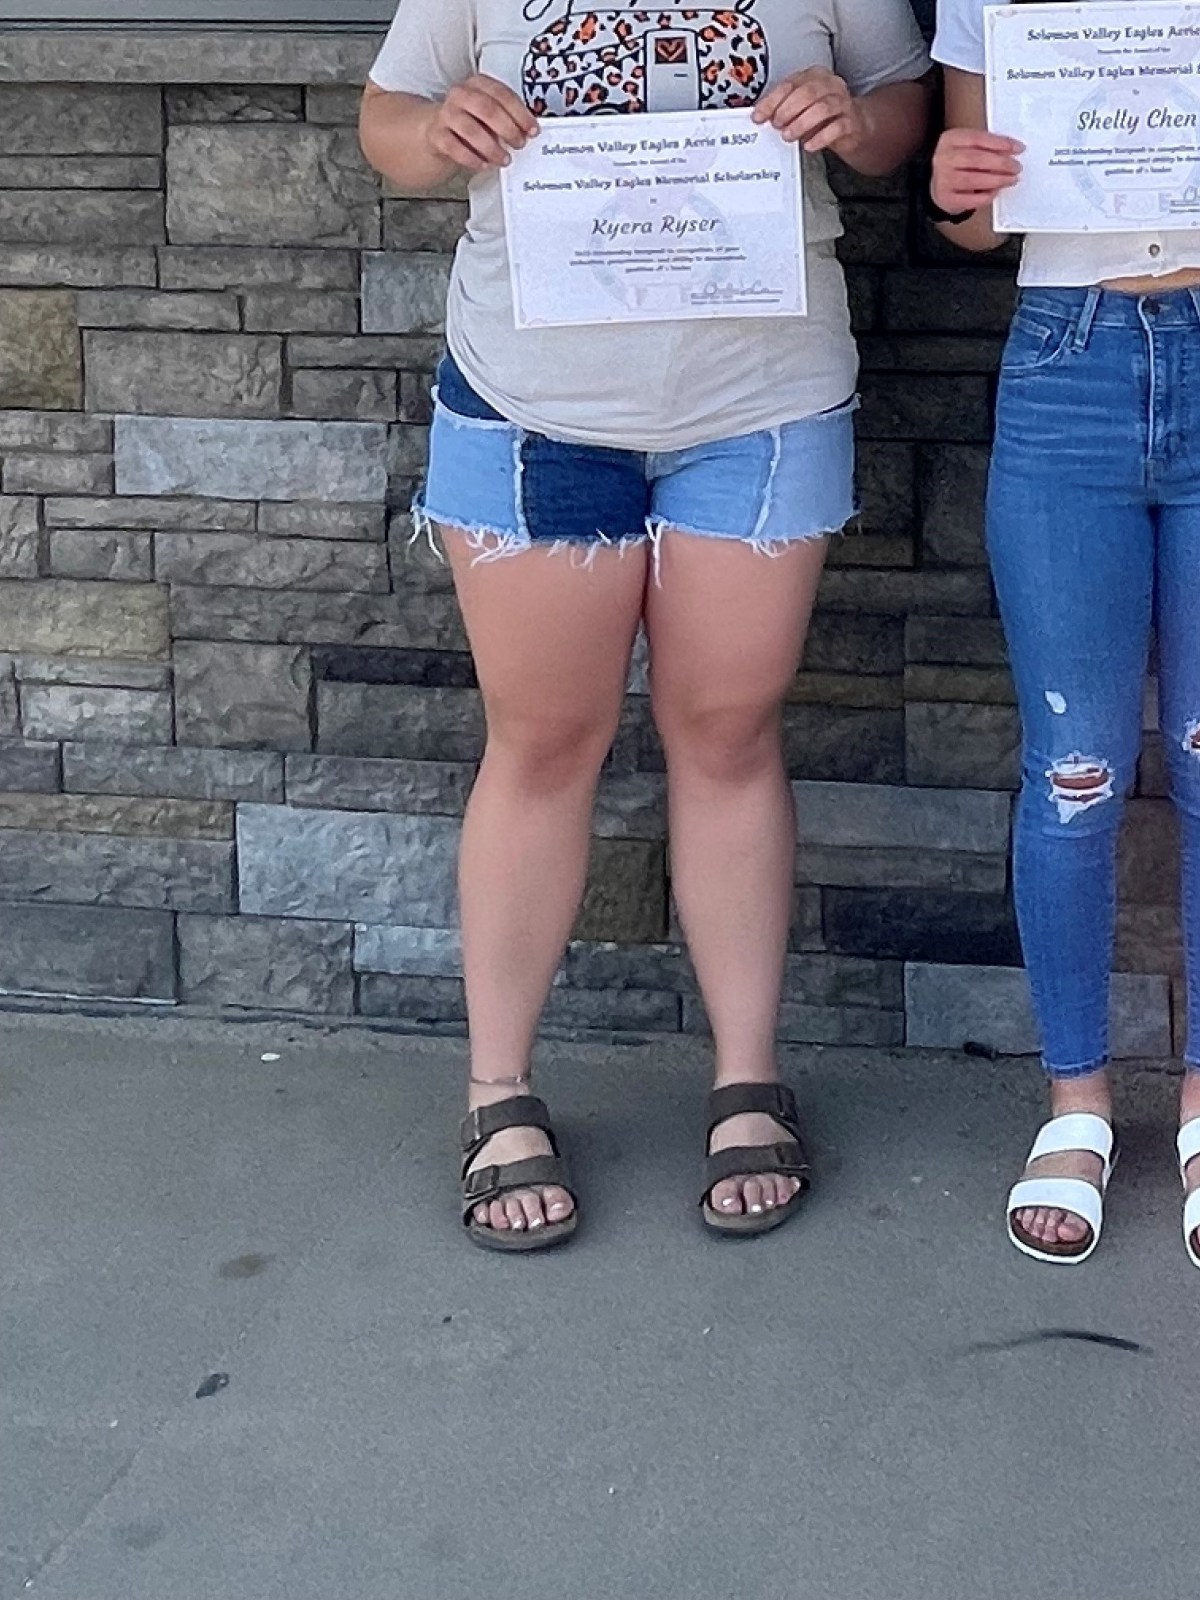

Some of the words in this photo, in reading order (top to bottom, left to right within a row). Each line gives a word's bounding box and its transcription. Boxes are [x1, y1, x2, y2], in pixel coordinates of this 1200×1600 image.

[1027, 28, 1079, 41] Solomon
[1082, 26, 1121, 42] Valley
[1125, 25, 1164, 42] Eagles
[1058, 66, 1095, 81] Valley
[1099, 64, 1135, 81] Eagles
[1138, 62, 1193, 77] Memorial
[1077, 108, 1140, 135] Shelly
[1146, 106, 1197, 129] Chen
[598, 140, 637, 156] Valley
[640, 138, 680, 154] Eagles
[592, 217, 653, 241] Kyera
[659, 214, 722, 239] Ryser
